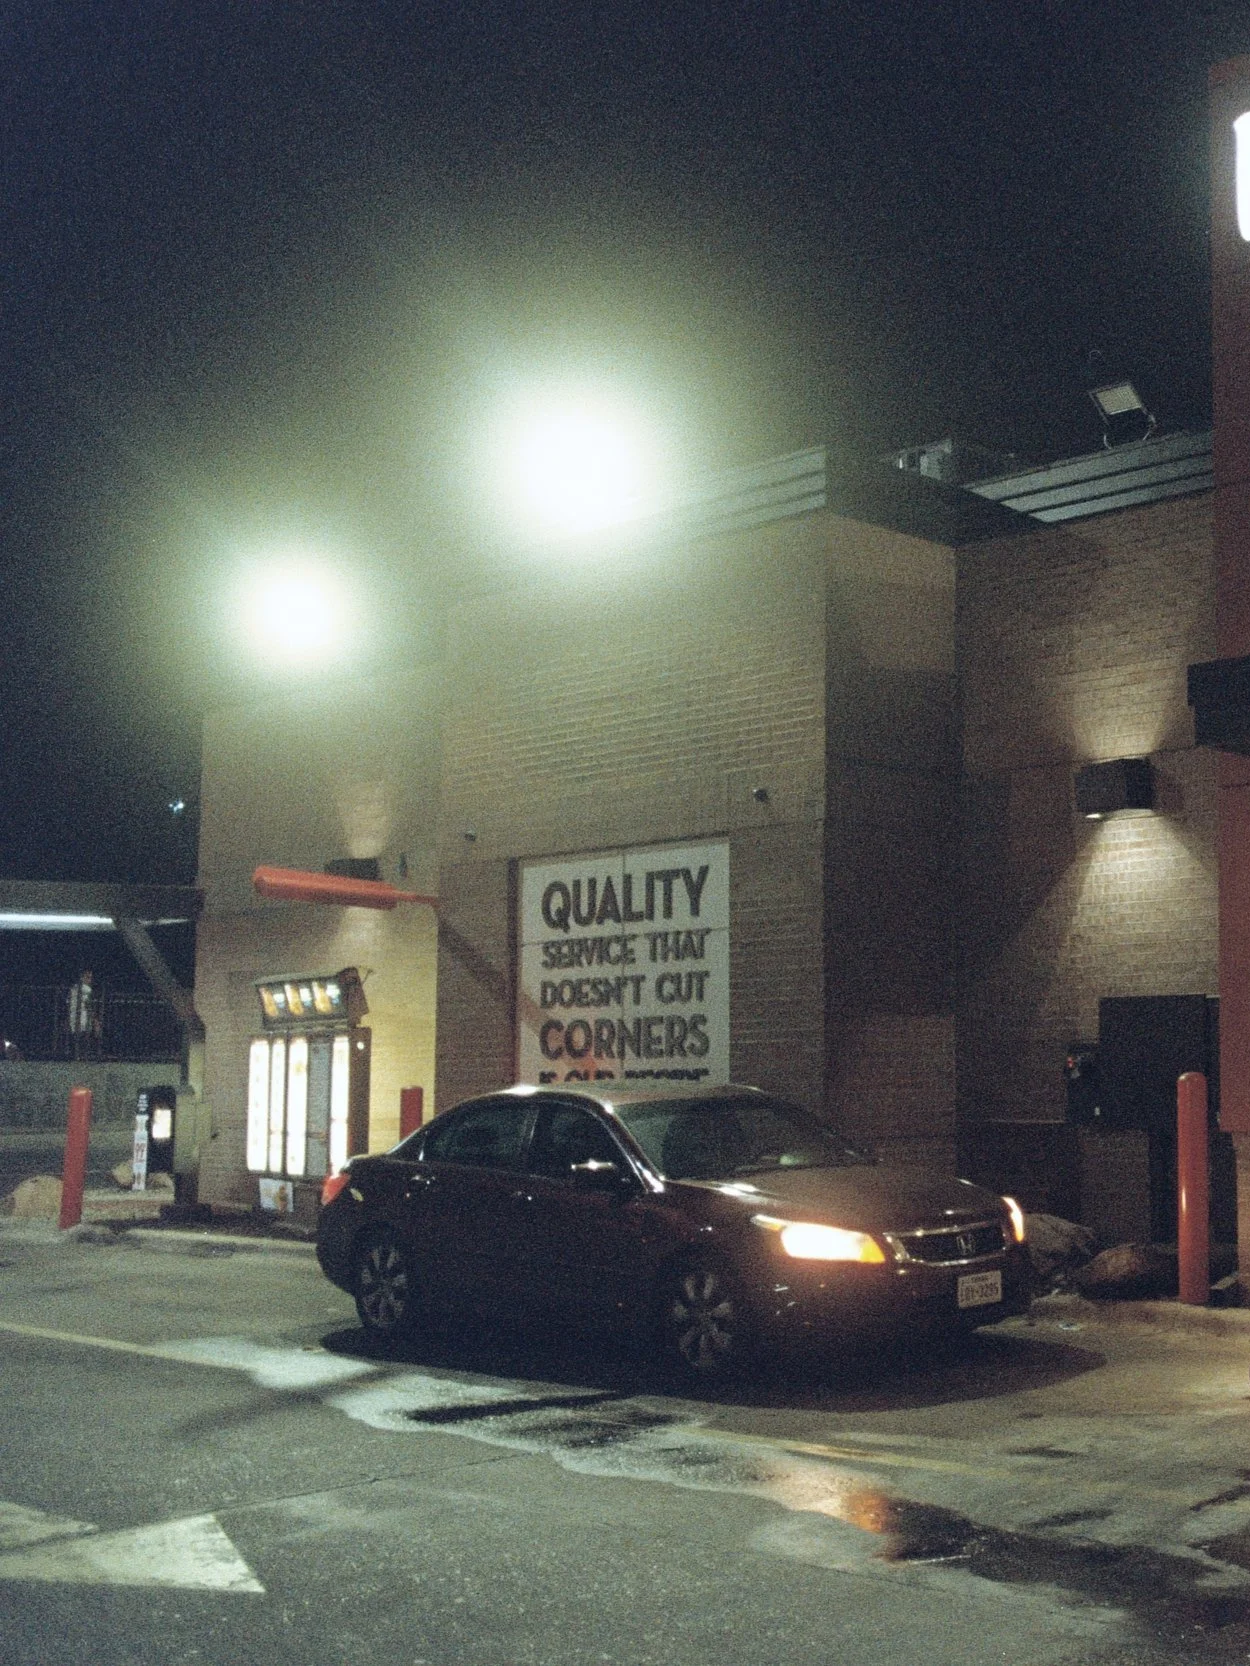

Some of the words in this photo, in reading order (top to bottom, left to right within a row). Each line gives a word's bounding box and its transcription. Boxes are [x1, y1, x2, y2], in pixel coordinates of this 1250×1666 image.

[541, 865, 710, 933] QUALITY
[541, 933, 636, 969] SERVICE
[649, 927, 711, 962] THAT
[540, 974, 646, 1009] DOESN'T
[655, 970, 710, 1004] CUT
[539, 1013, 710, 1060] CORNERS
